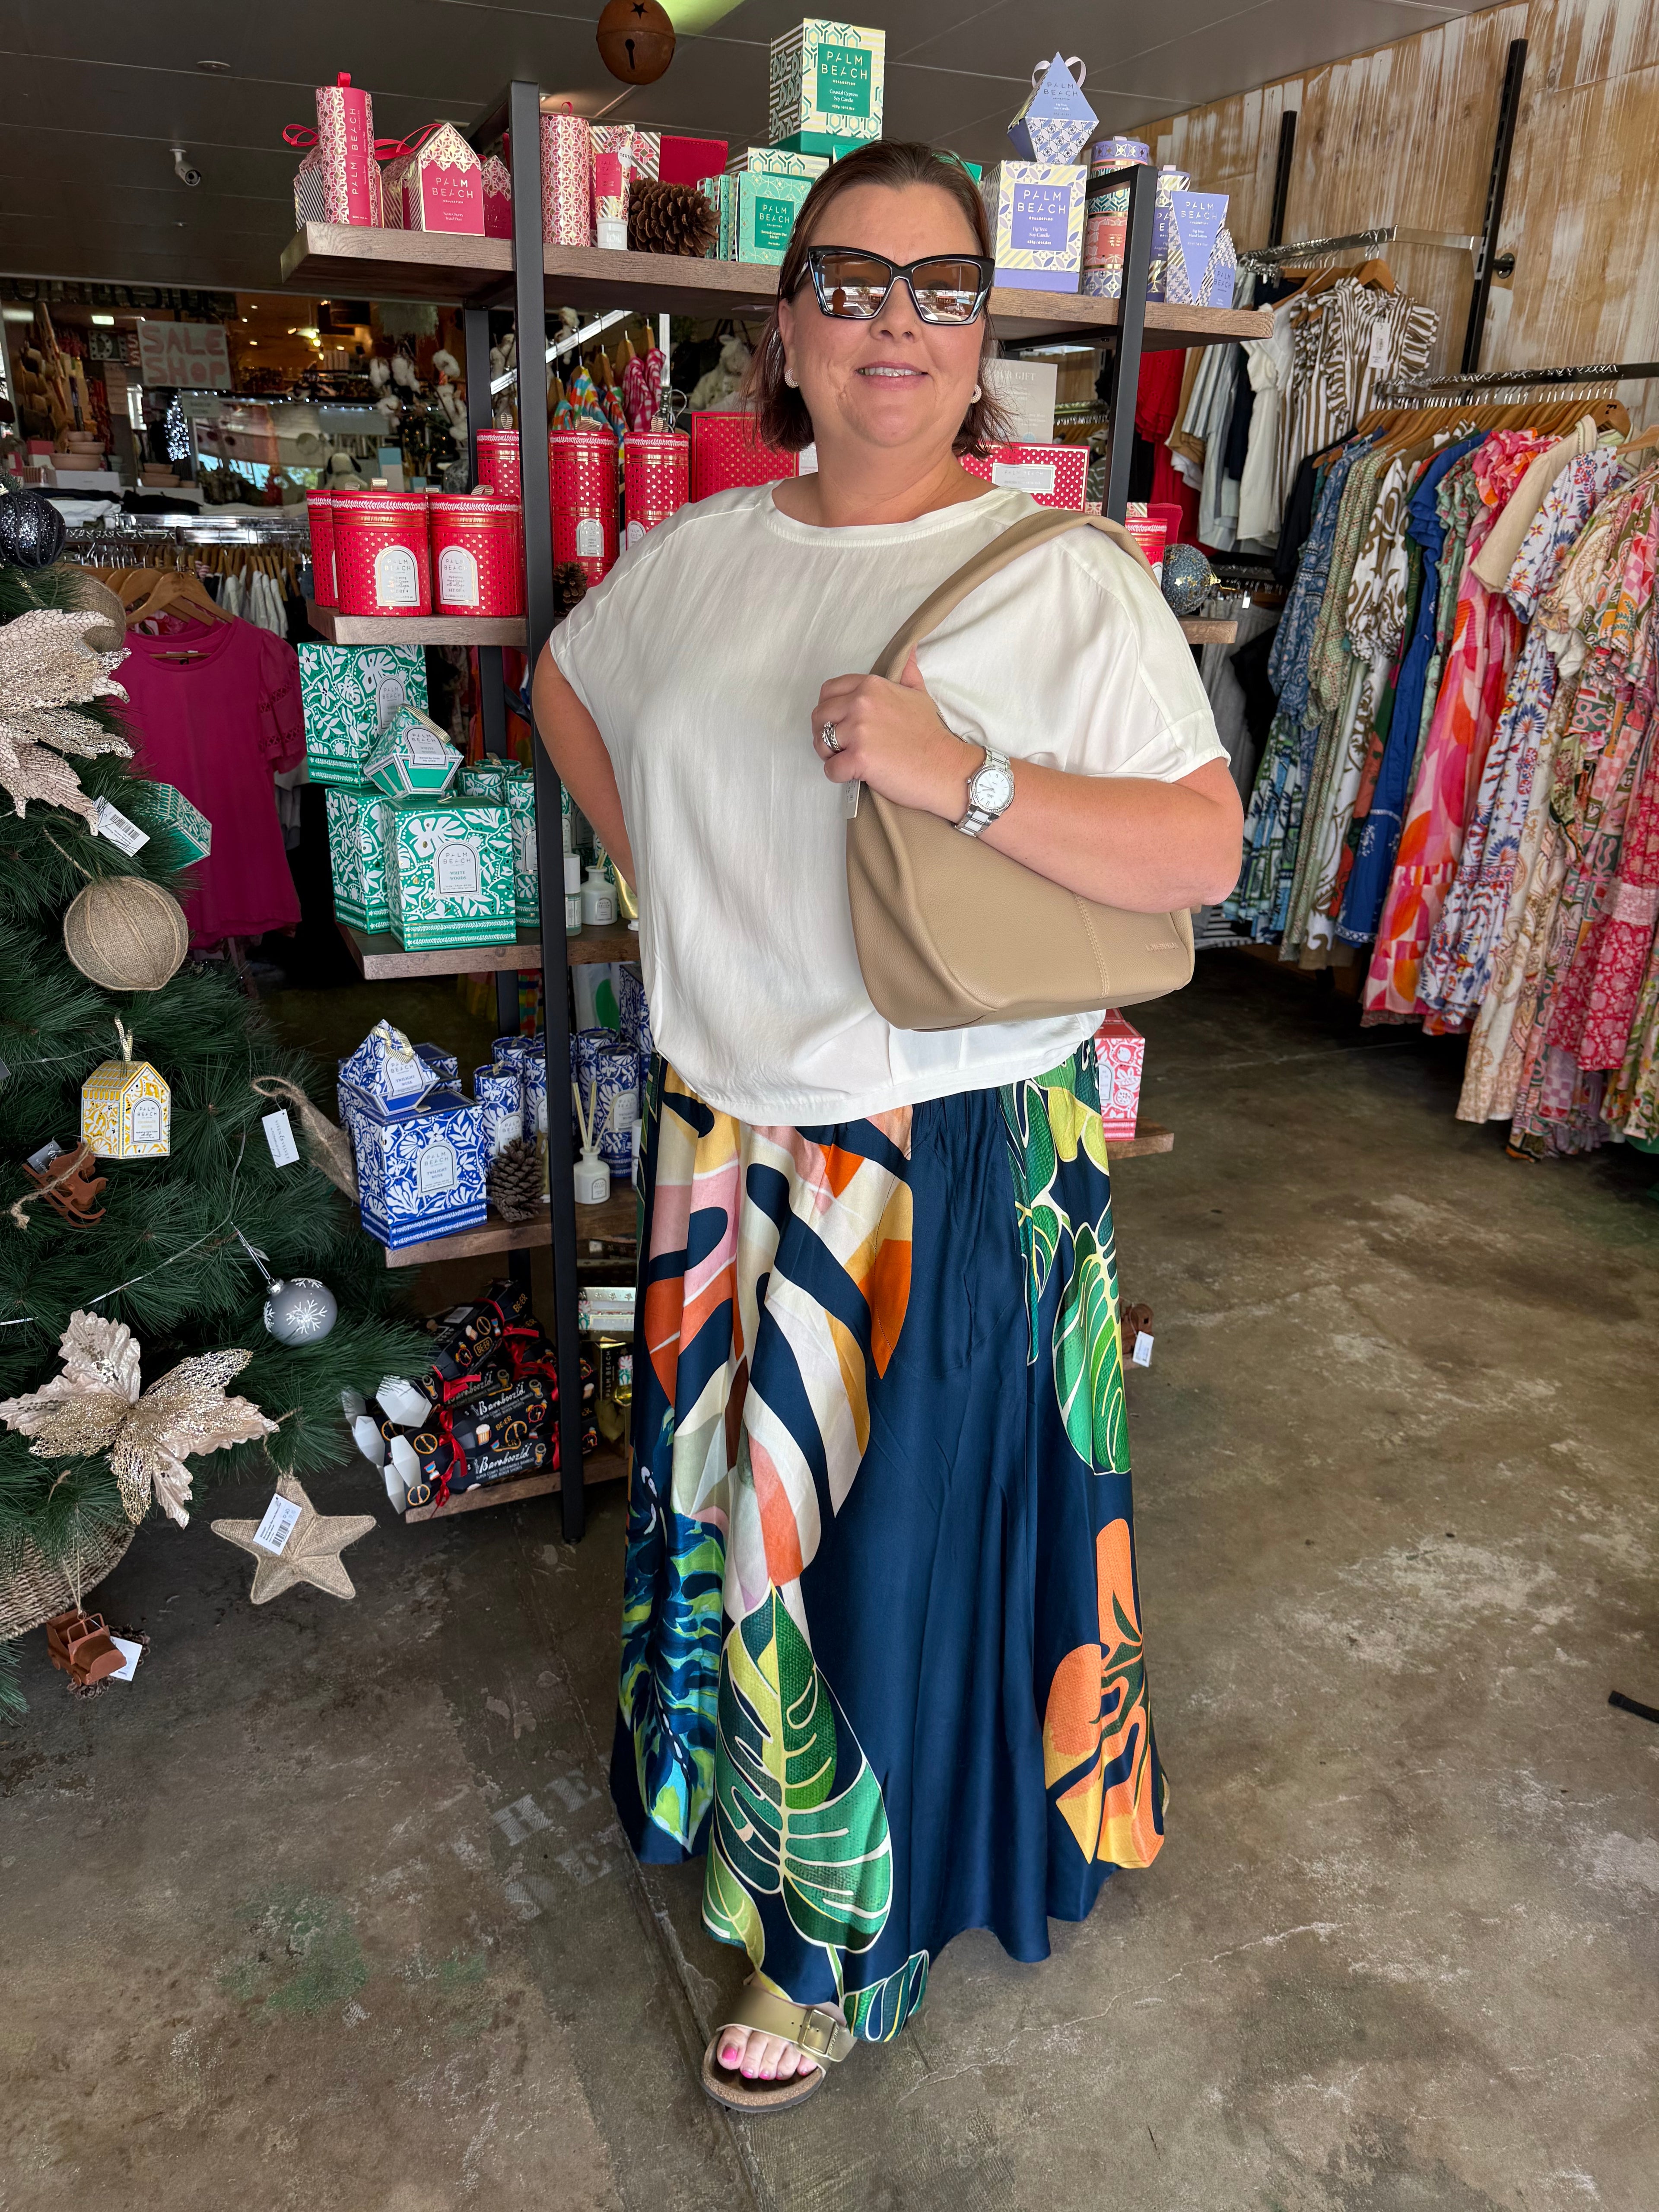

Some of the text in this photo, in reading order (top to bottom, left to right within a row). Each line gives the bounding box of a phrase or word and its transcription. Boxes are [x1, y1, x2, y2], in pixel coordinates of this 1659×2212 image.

[827, 51, 862, 66] PALM
[822, 64, 867, 80] BEACH
[350, 108, 359, 194] PALM BEACH
[436, 178, 468, 188] PALM
[432, 188, 473, 199] BEACH
[1023, 190, 1061, 201] PALM
[763, 204, 786, 214] PALM
[1017, 202, 1066, 214] BEACH
[1185, 201, 1214, 210] PALM
[760, 213, 790, 223] BEACH
[1181, 210, 1217, 220] BEACH
[1217, 271, 1231, 280] PALM
[1214, 279, 1231, 289] BEACH
[141, 324, 225, 356] SALE
[144, 356, 227, 388] SHOP
[1015, 371, 1036, 381] GIFT
[391, 1064, 413, 1073] BEACH
[424, 1157, 449, 1166] BEACH
[427, 1167, 447, 1175] TWILIGHT
